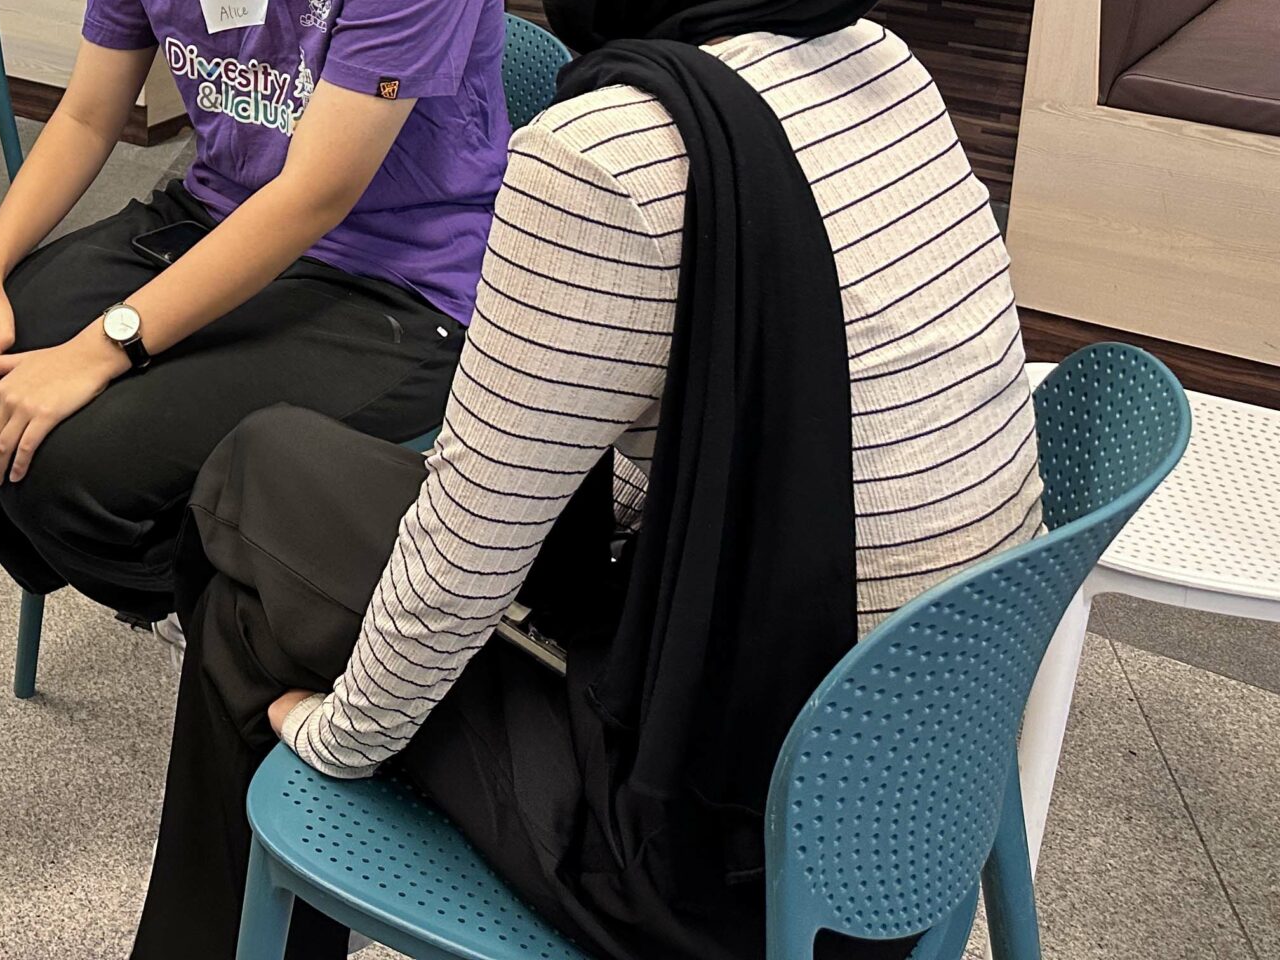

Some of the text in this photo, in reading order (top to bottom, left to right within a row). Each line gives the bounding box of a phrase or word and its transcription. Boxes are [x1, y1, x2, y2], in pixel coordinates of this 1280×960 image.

[220, 4, 249, 22] Alice
[166, 37, 291, 108] Divesity
[197, 82, 222, 113] &
